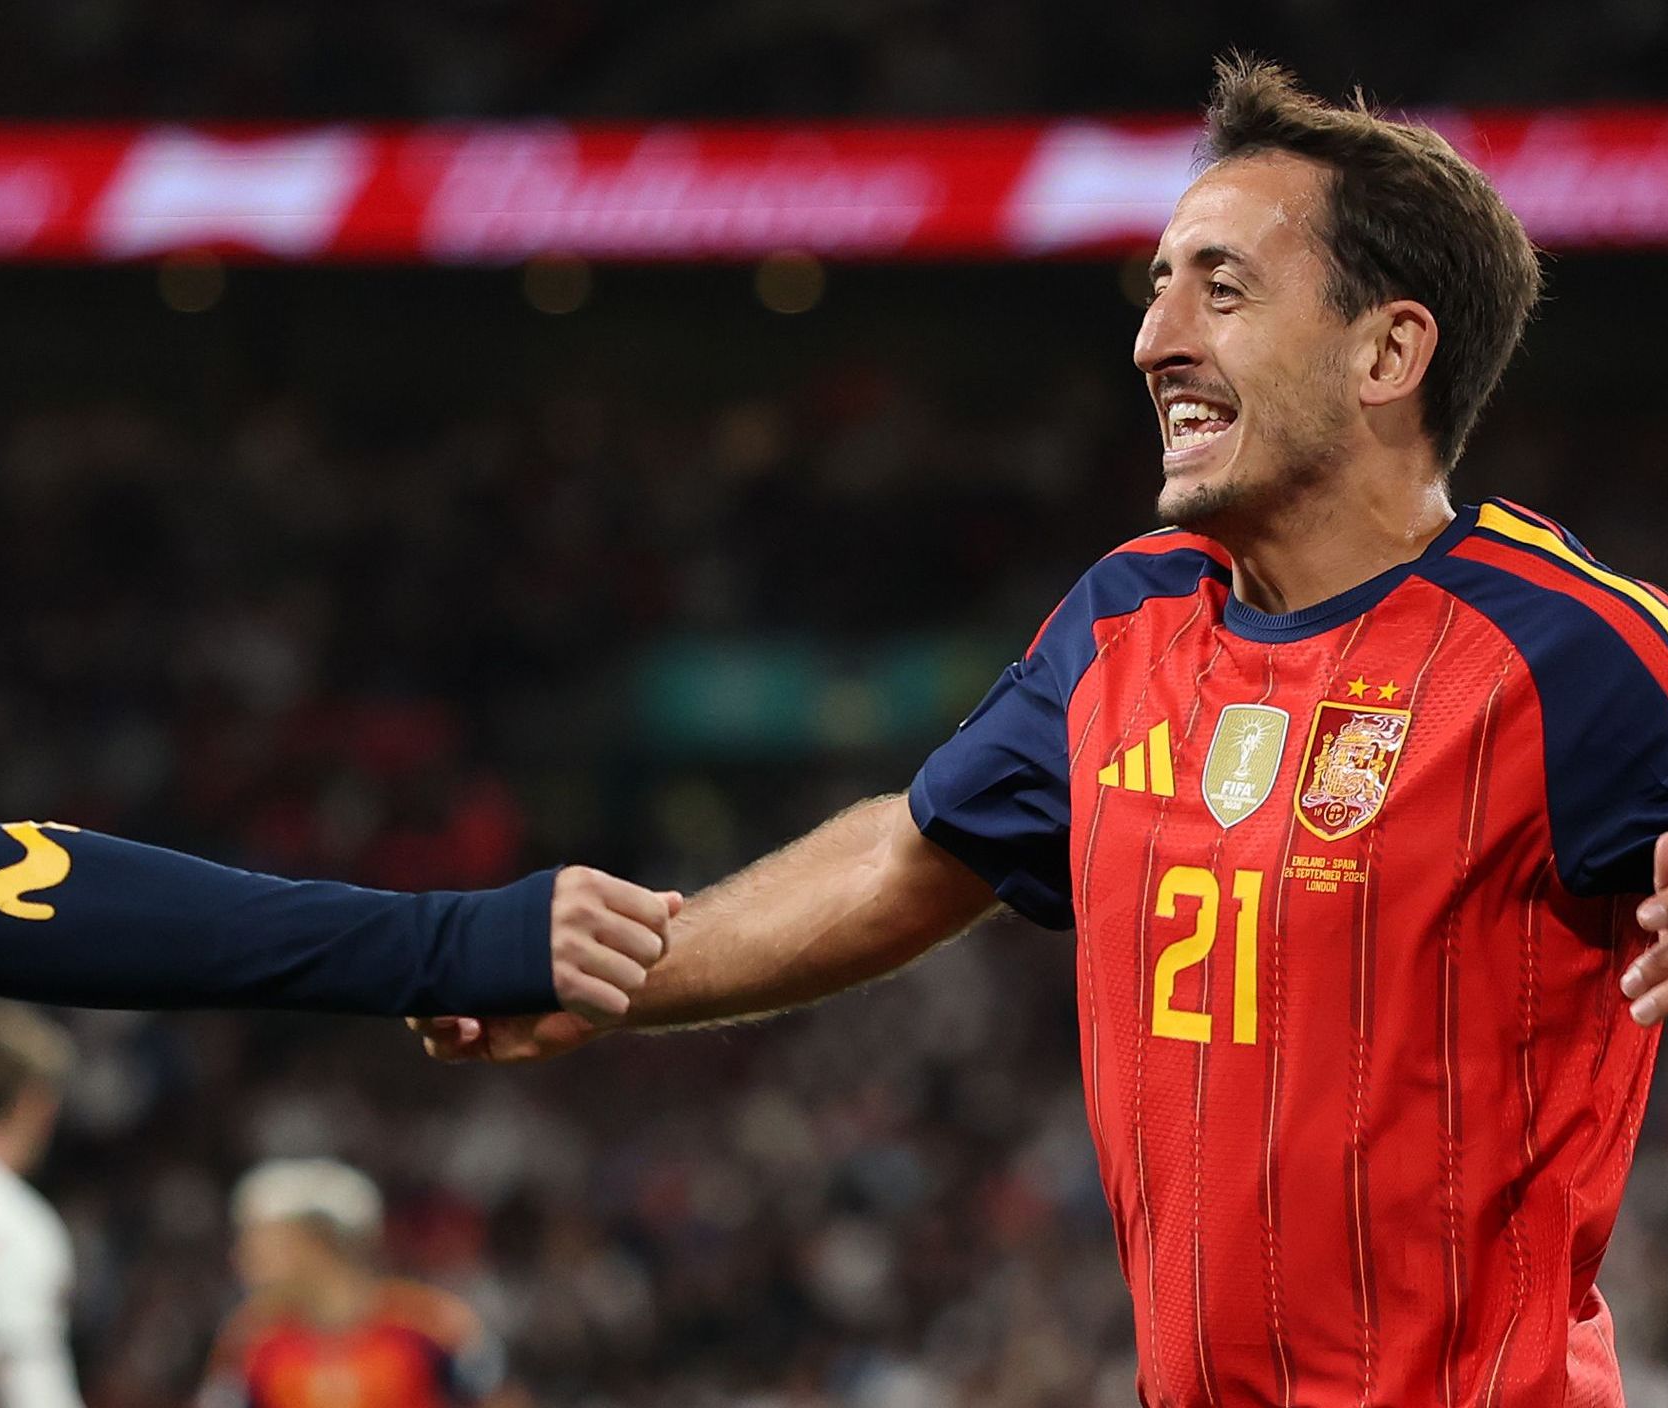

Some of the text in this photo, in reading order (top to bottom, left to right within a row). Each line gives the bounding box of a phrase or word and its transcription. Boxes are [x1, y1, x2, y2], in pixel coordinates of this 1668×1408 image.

[1221, 780, 1253, 797] FIFA
[1292, 855, 1326, 868] ENGLAND
[1333, 858, 1358, 870] SPAIN
[1284, 866, 1366, 883] 26 SEPTEMBER 2026
[1306, 880, 1338, 893] LONDON
[1152, 865, 1264, 1045] 21
